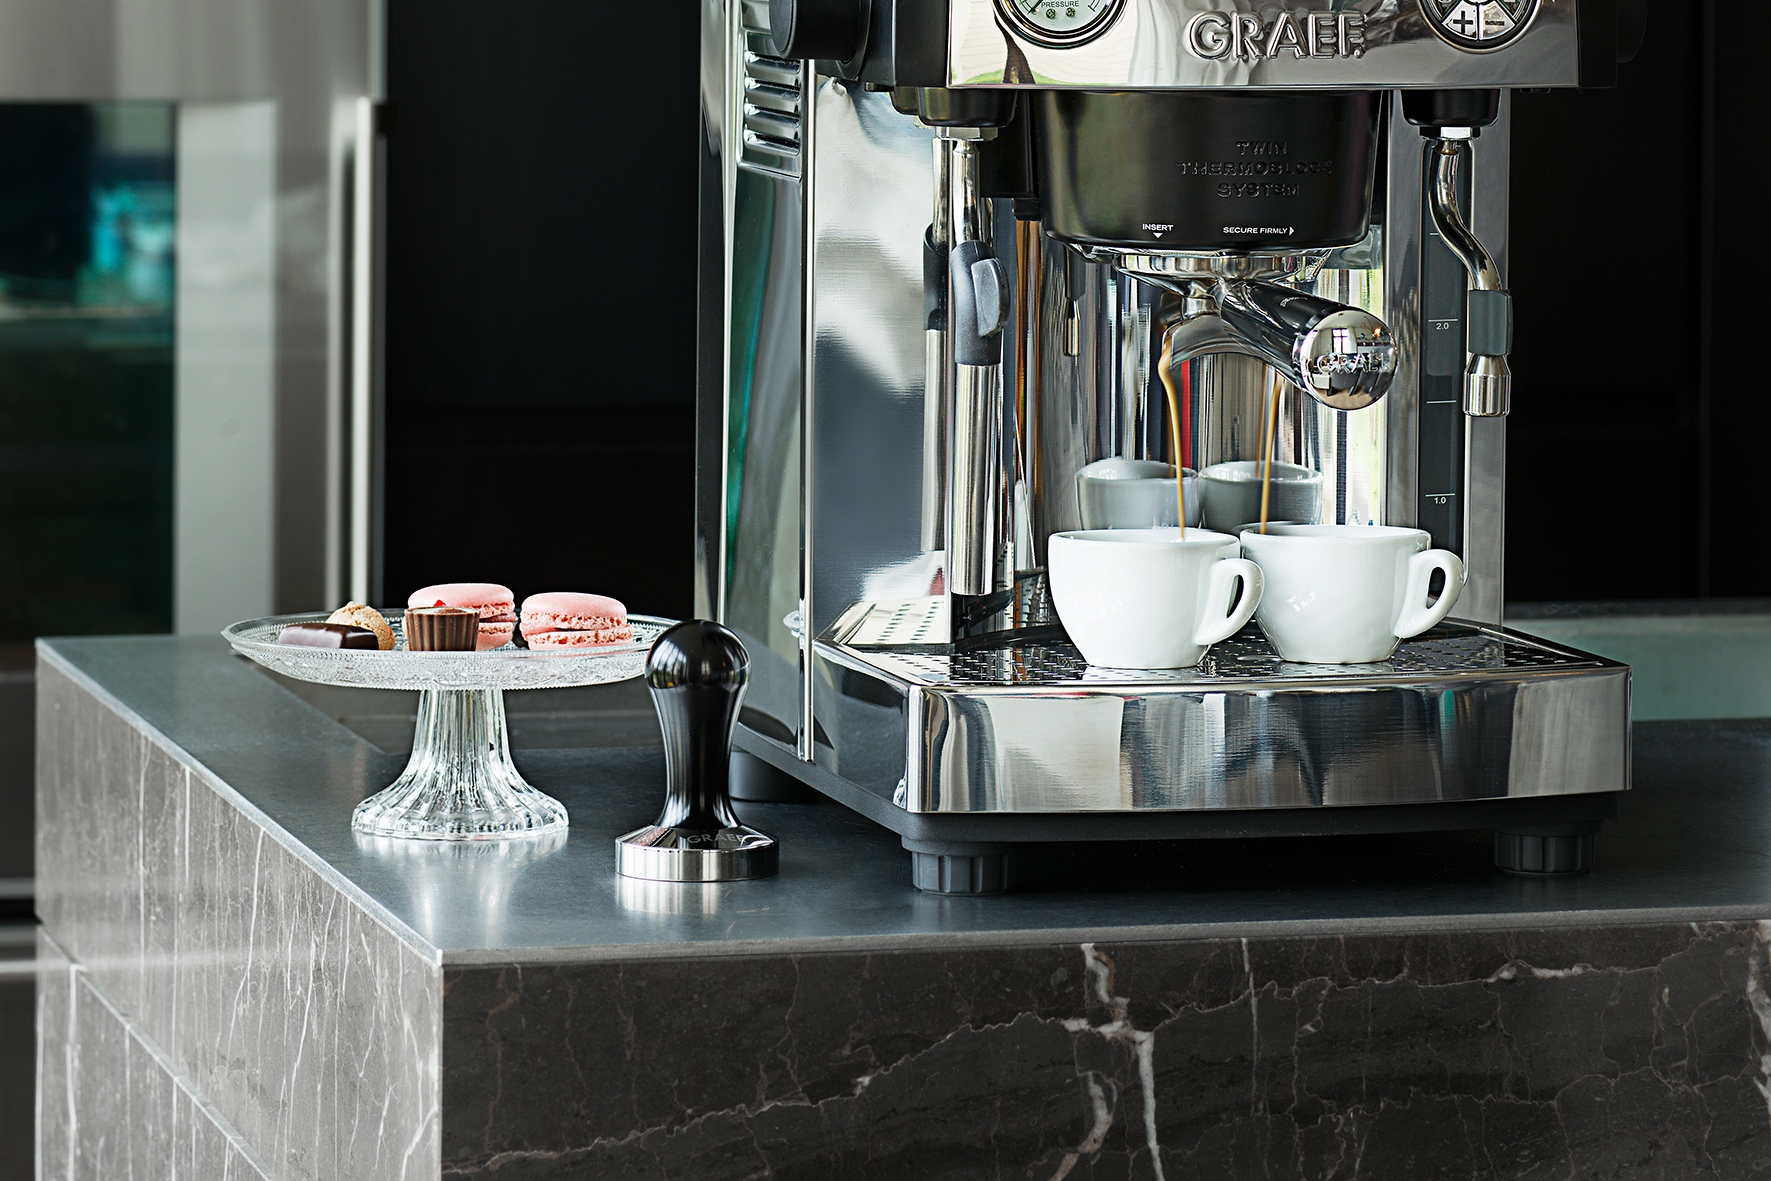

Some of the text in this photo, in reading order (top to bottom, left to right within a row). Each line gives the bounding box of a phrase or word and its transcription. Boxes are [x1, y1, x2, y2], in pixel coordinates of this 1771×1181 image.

[1041, 0, 1080, 8] PRESSURE
[1236, 141, 1288, 156] TWIN
[1217, 182, 1300, 198] SYSTEM
[1142, 223, 1174, 232] INSERT
[1222, 226, 1288, 235] SECURE FIRMLY
[1435, 322, 1450, 330] 2.0
[1433, 496, 1447, 504] 1.0
